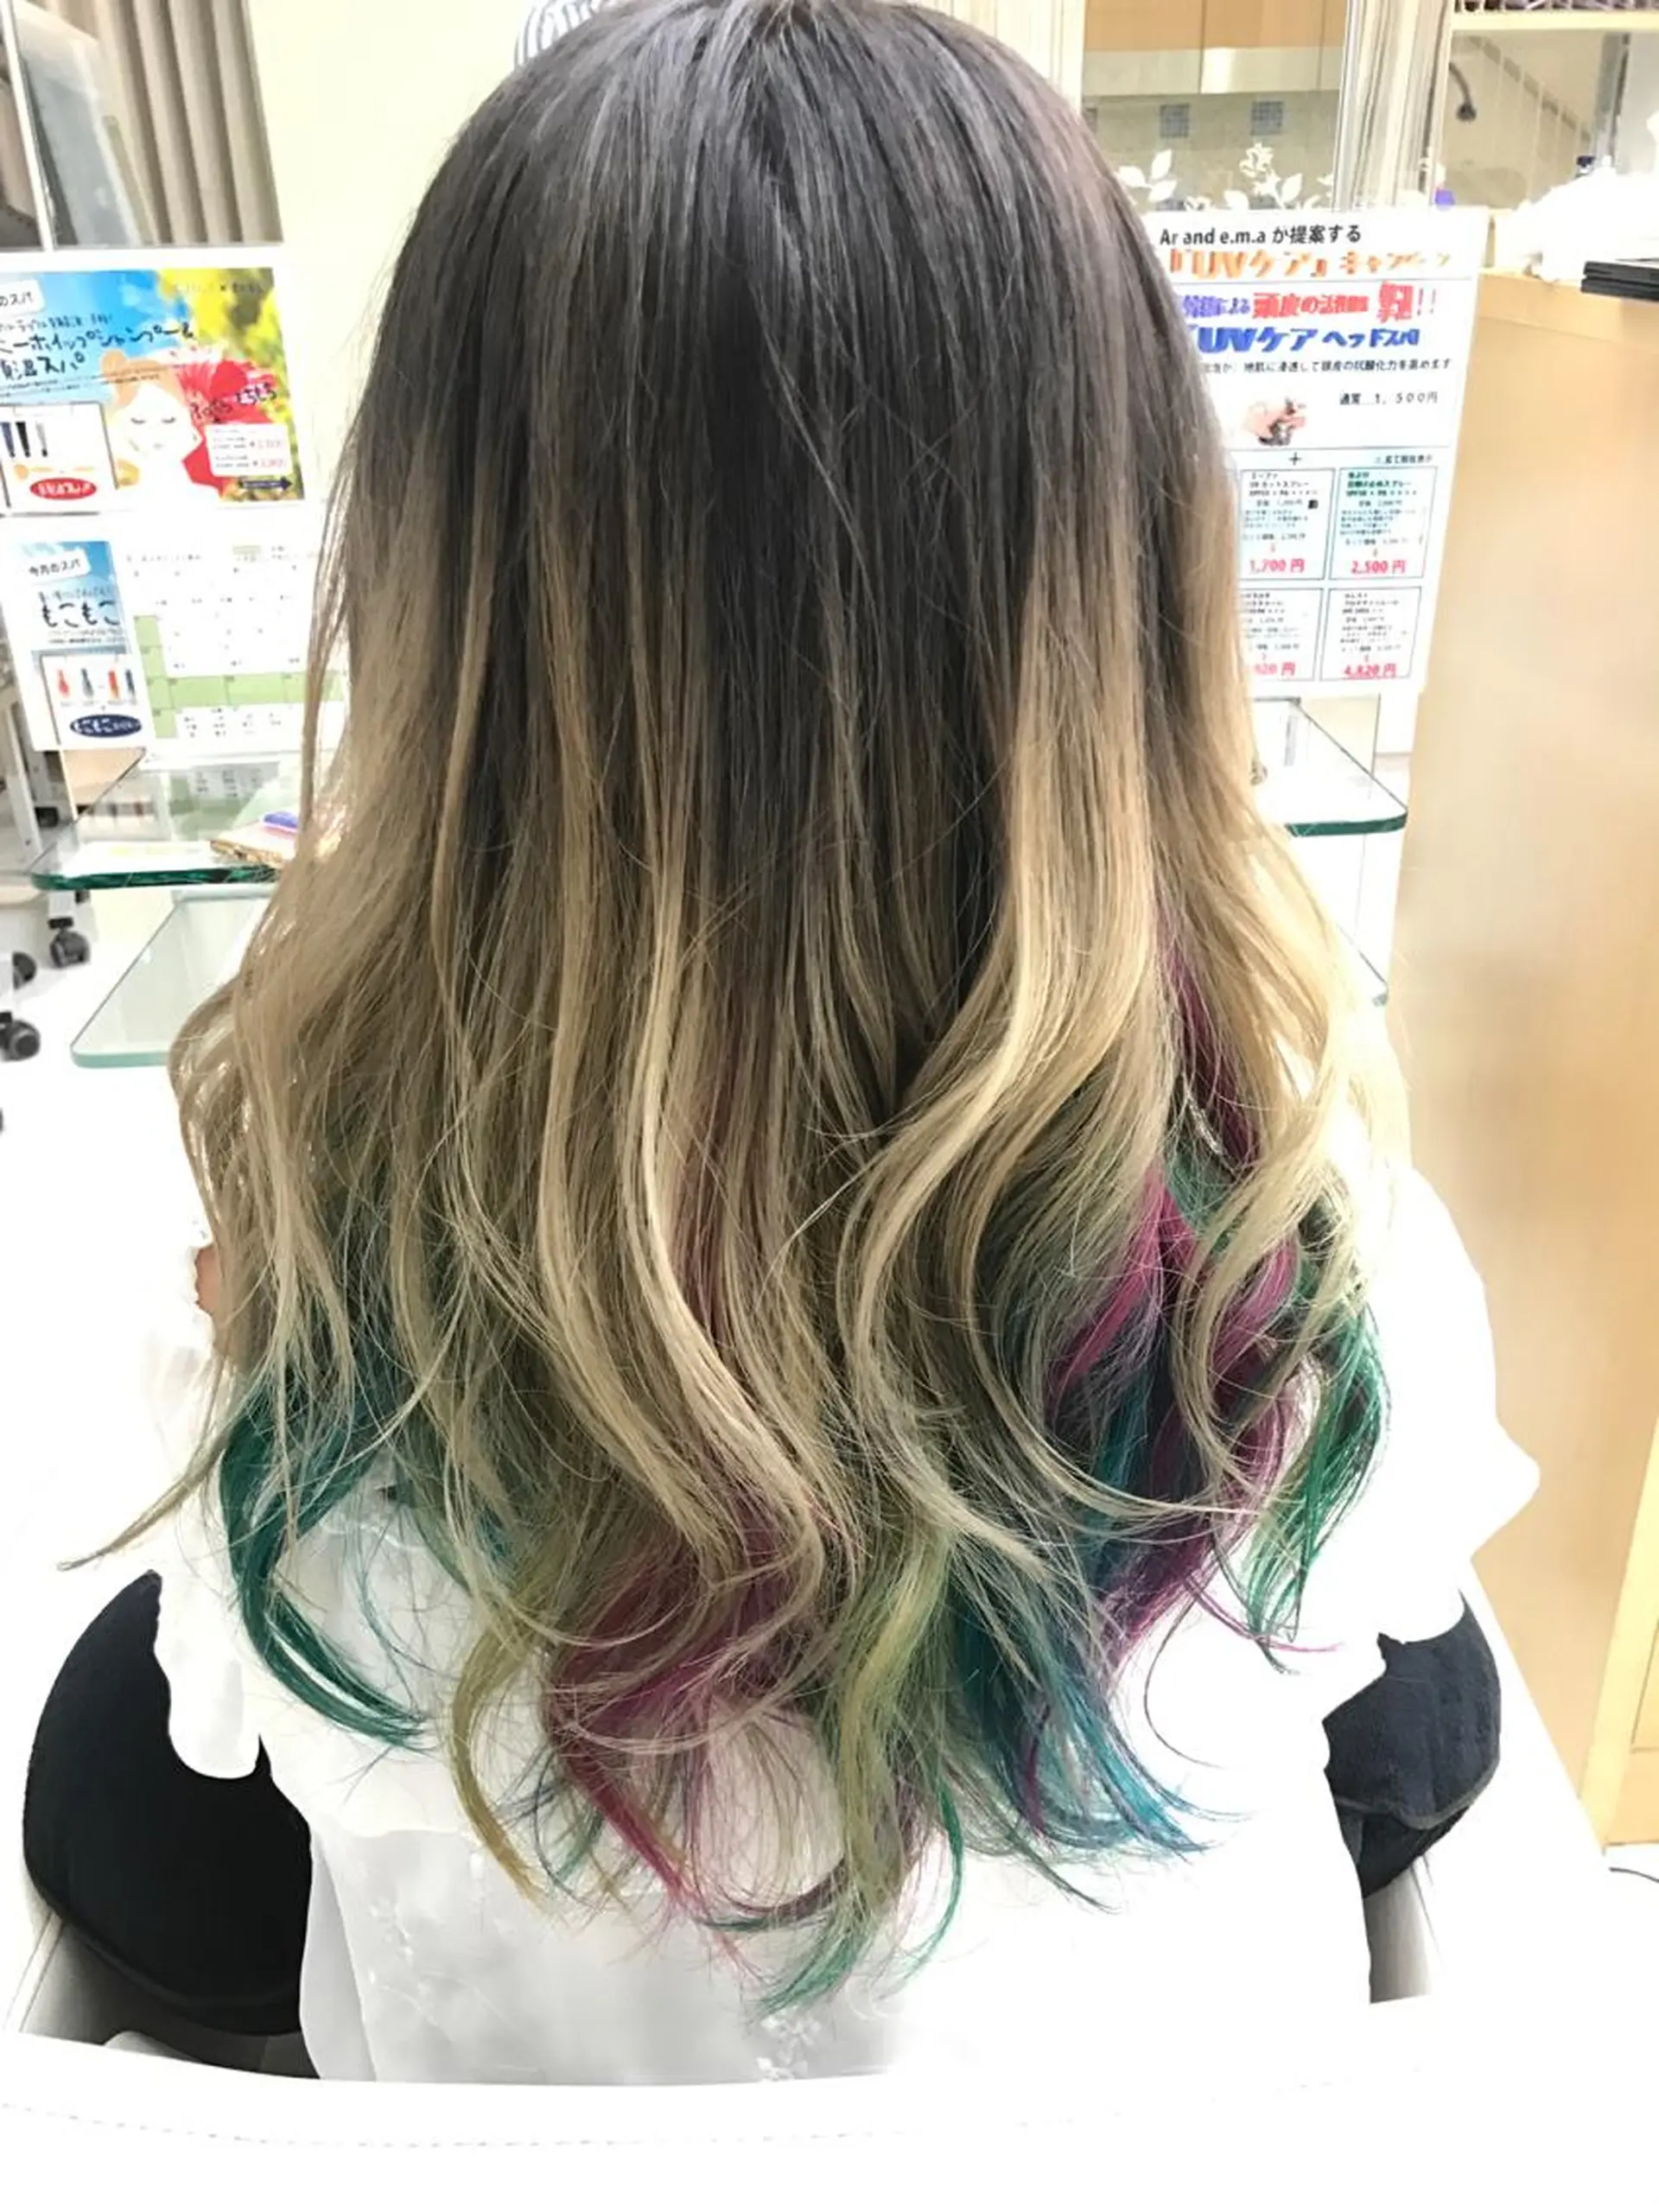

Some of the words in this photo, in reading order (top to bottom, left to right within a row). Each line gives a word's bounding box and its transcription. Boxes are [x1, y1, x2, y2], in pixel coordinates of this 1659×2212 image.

[1160, 228, 1179, 245] Ar
[1182, 227, 1216, 245] and
[1219, 229, 1267, 245] e.m.a
